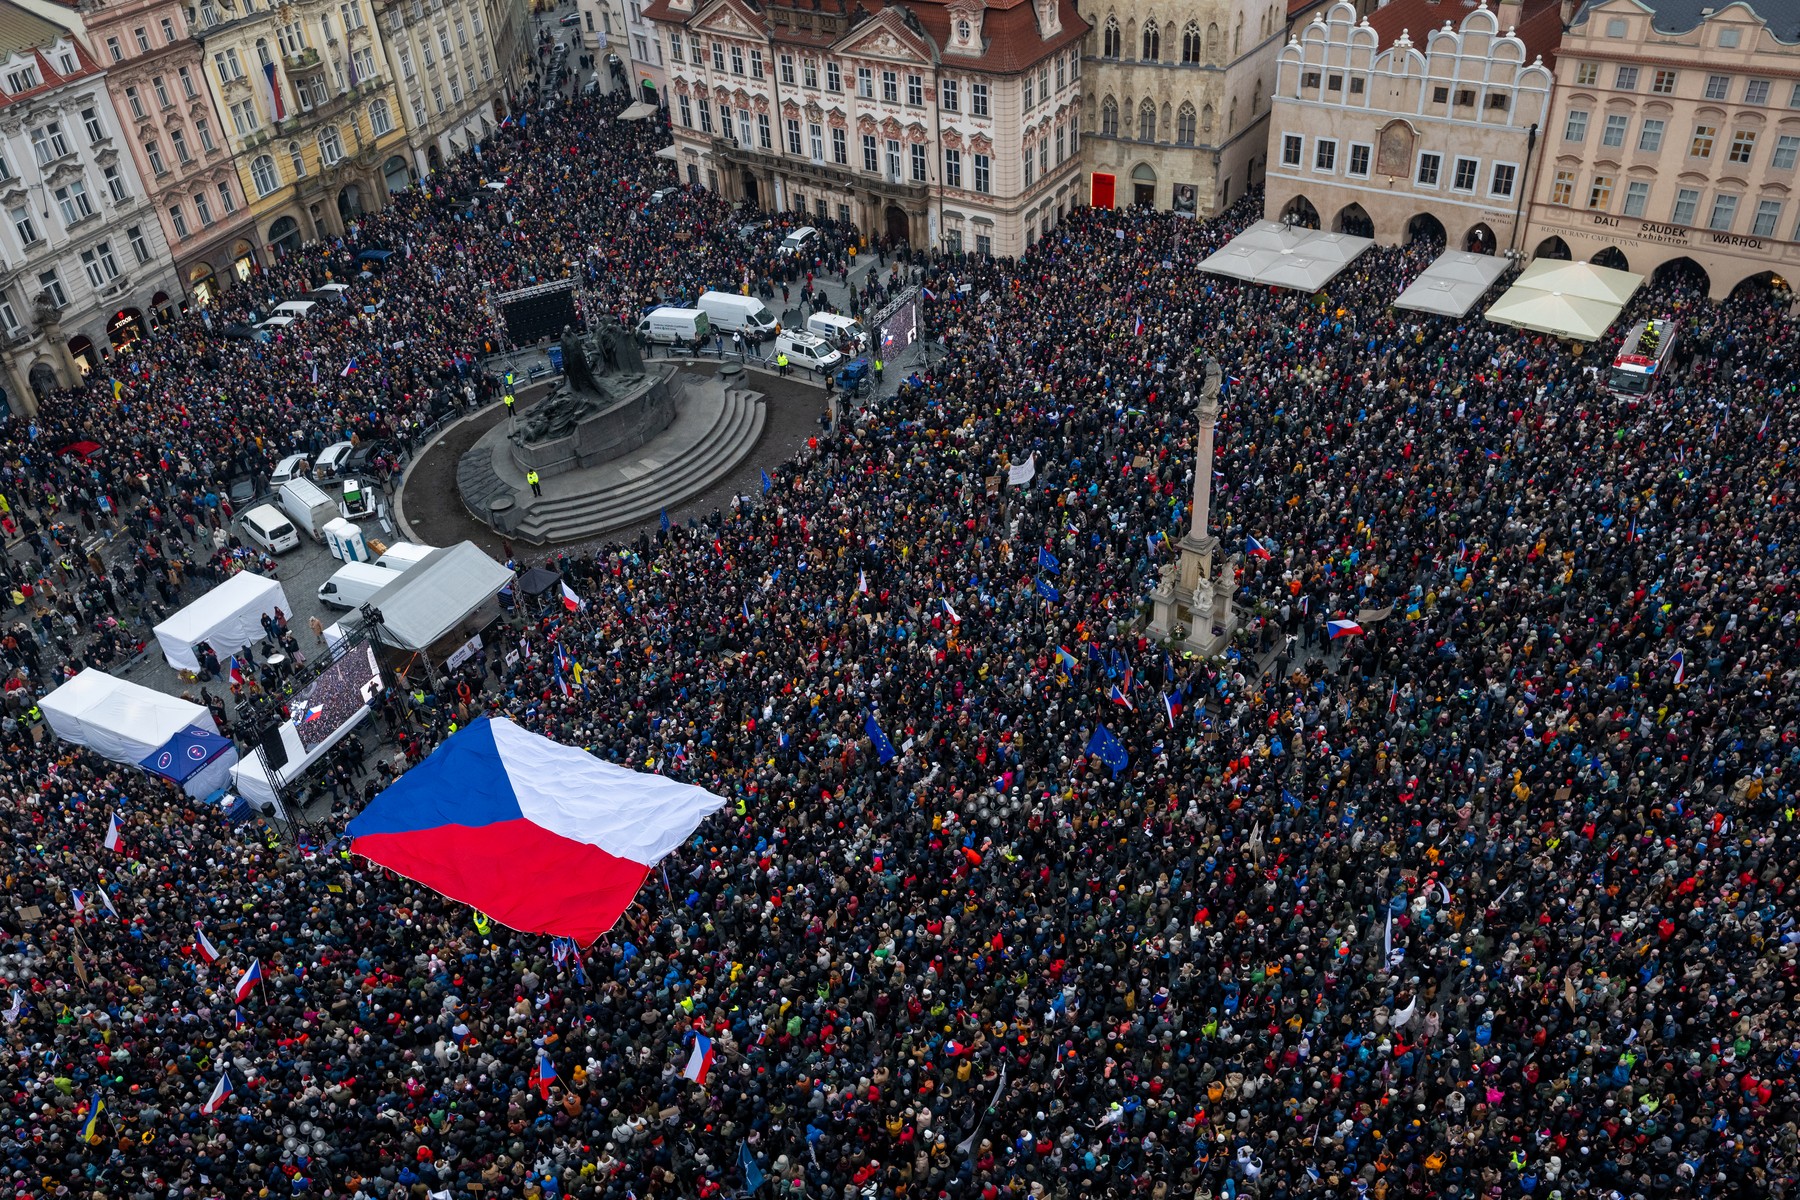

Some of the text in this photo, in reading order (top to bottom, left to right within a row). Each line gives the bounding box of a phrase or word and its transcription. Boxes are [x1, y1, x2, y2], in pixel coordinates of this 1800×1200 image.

[1594, 215, 1619, 227] DALI
[1541, 226, 1590, 239] RESTAURANT
[1641, 223, 1687, 237] SAUDEK
[1637, 232, 1688, 245] exhibition
[1713, 234, 1763, 249] WARHOL
[115, 315, 133, 328] TUDOR
